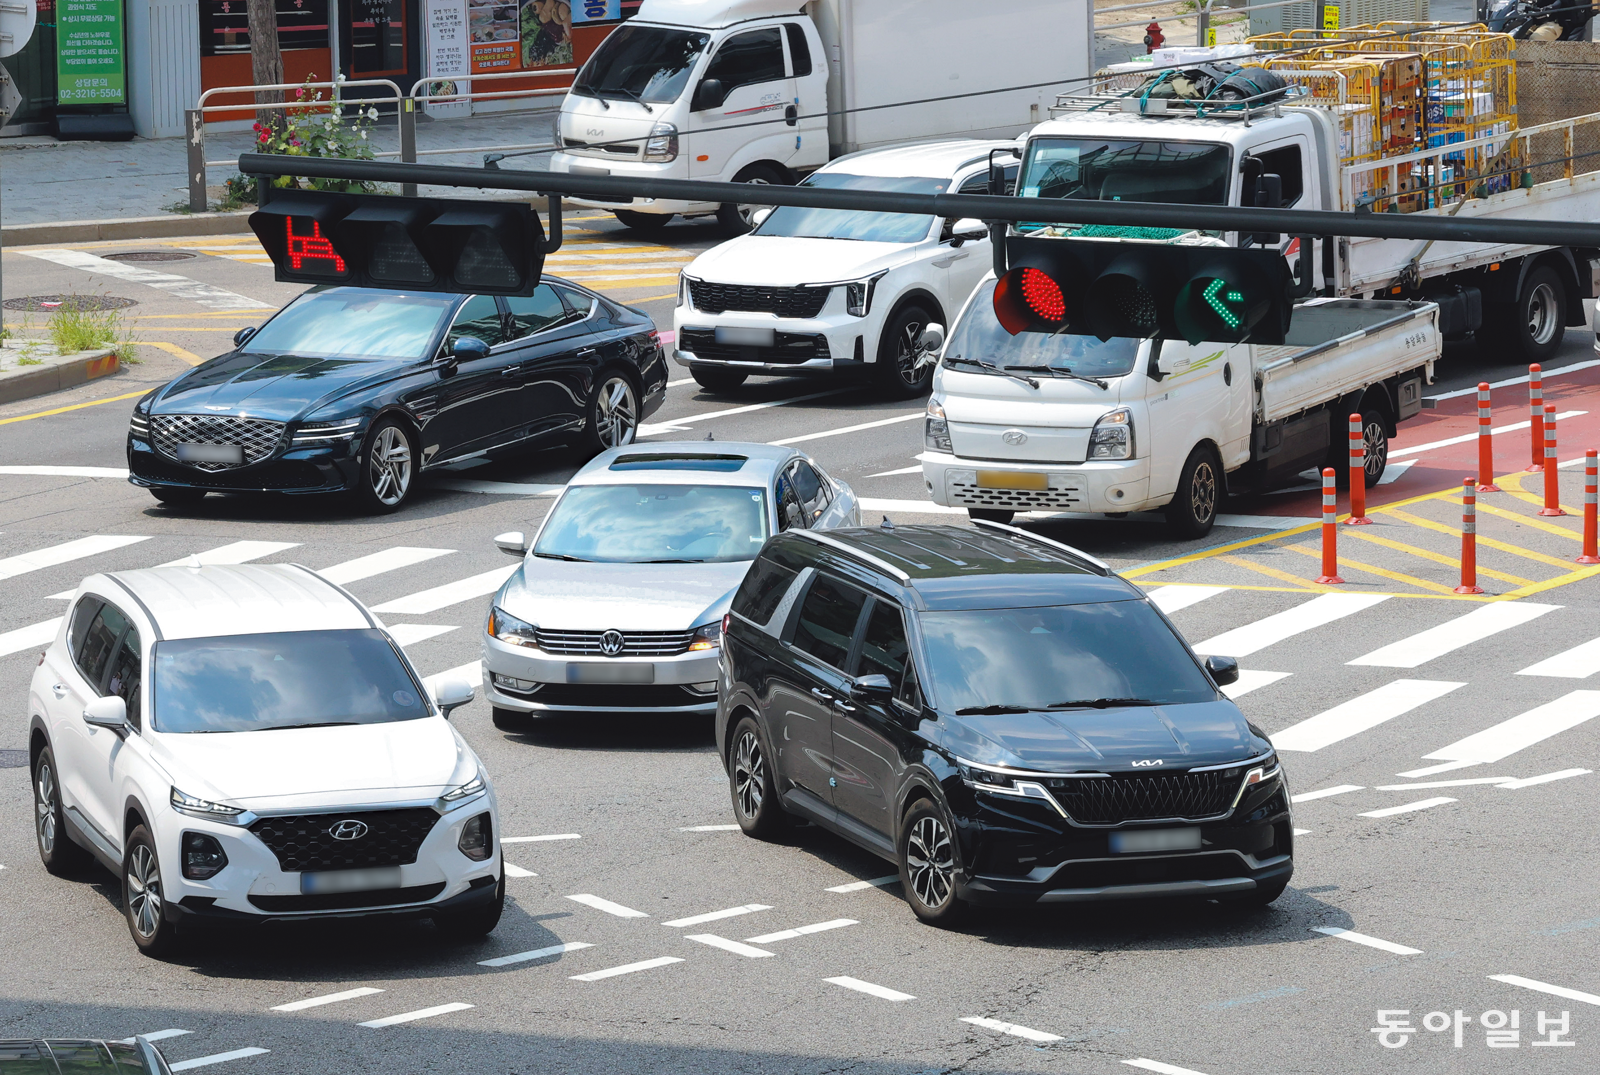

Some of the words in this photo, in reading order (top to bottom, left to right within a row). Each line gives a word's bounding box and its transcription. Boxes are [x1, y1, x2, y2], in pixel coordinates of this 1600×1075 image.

[68, 15, 80, 23] 상시
[75, 78, 108, 87] 상담문의
[60, 88, 122, 98] 02-3216-5504
[586, 128, 604, 137] KIA
[1132, 759, 1163, 768] KIA
